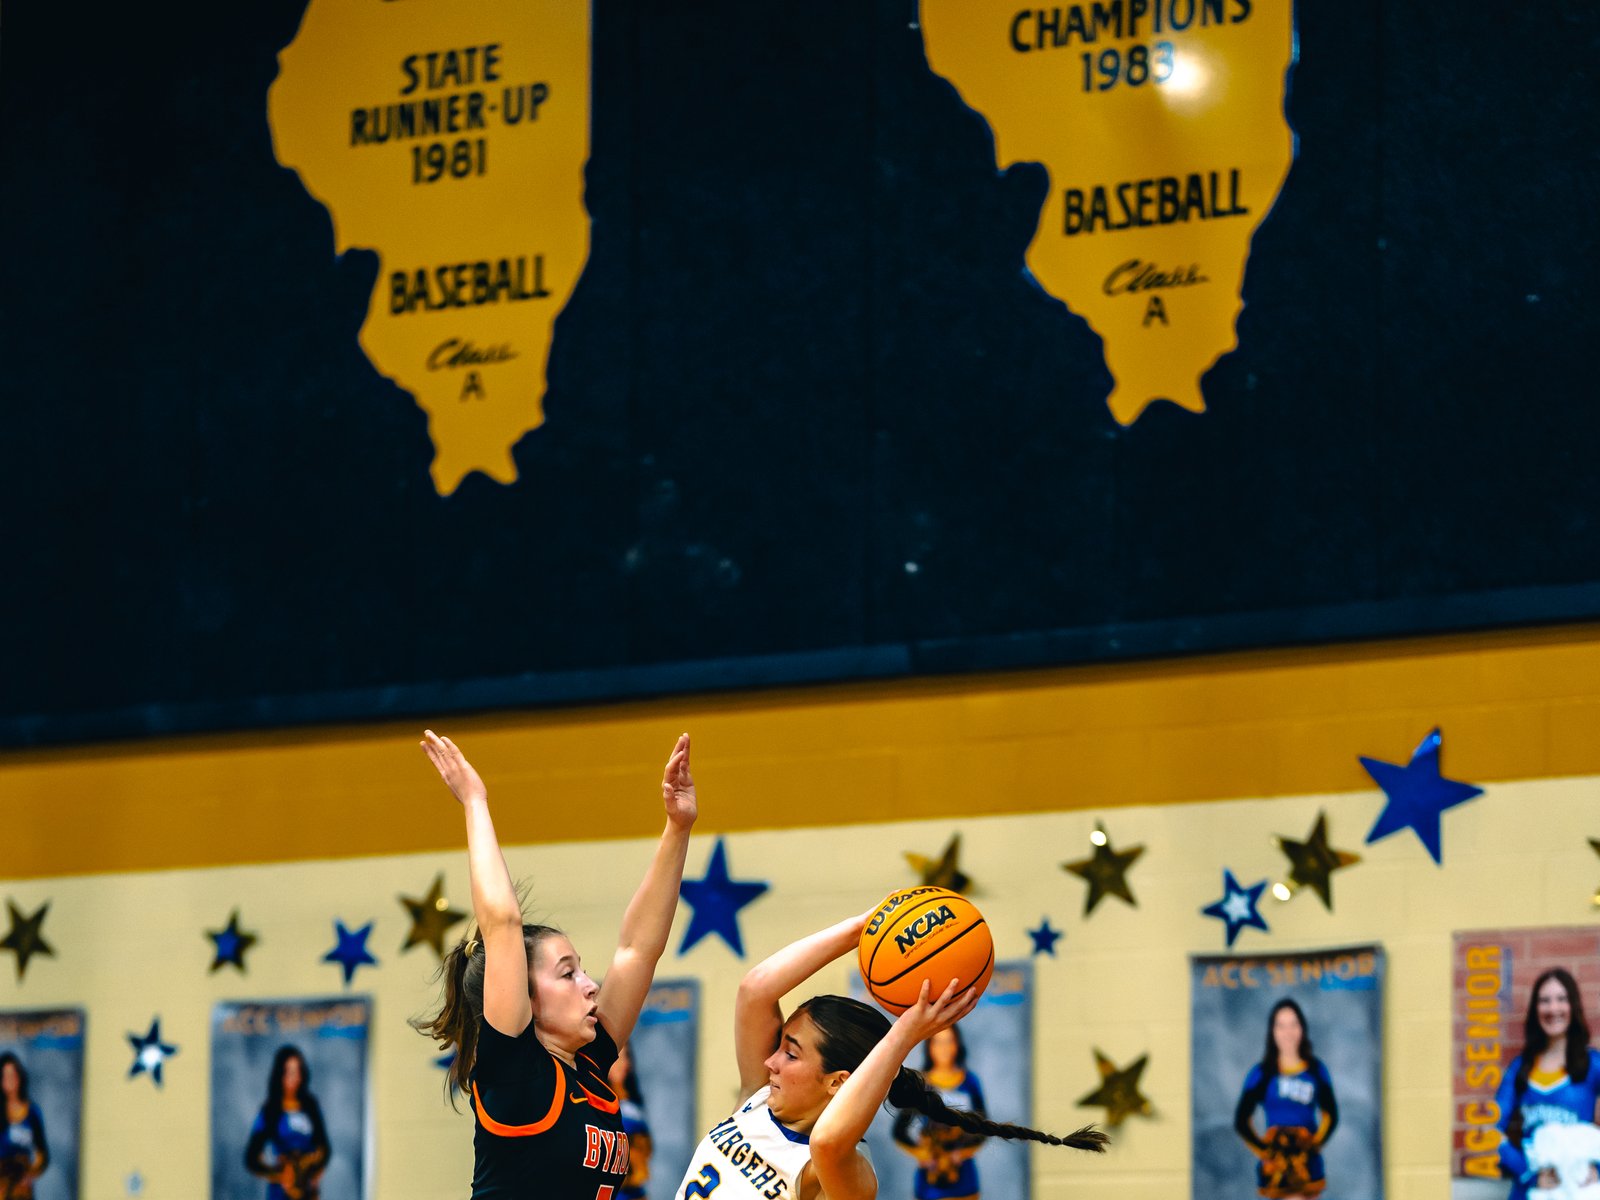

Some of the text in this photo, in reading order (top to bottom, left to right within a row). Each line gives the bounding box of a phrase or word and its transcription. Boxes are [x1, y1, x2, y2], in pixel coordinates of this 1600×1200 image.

[1009, 0, 1252, 52] CHAMPIONS
[400, 44, 502, 95] STATE
[1081, 41, 1175, 92] 1983
[350, 83, 549, 147] RUNNER-UP
[412, 139, 488, 185] 1981
[1064, 169, 1249, 236] BASEBALL
[390, 255, 551, 315] BASEBALL
[1143, 297, 1169, 327] A
[460, 372, 486, 402] A
[865, 887, 944, 936] Wilson
[894, 904, 957, 955] NCAA
[1203, 960, 1260, 989] ACC
[1464, 945, 1501, 1178] ACC SENIOR
